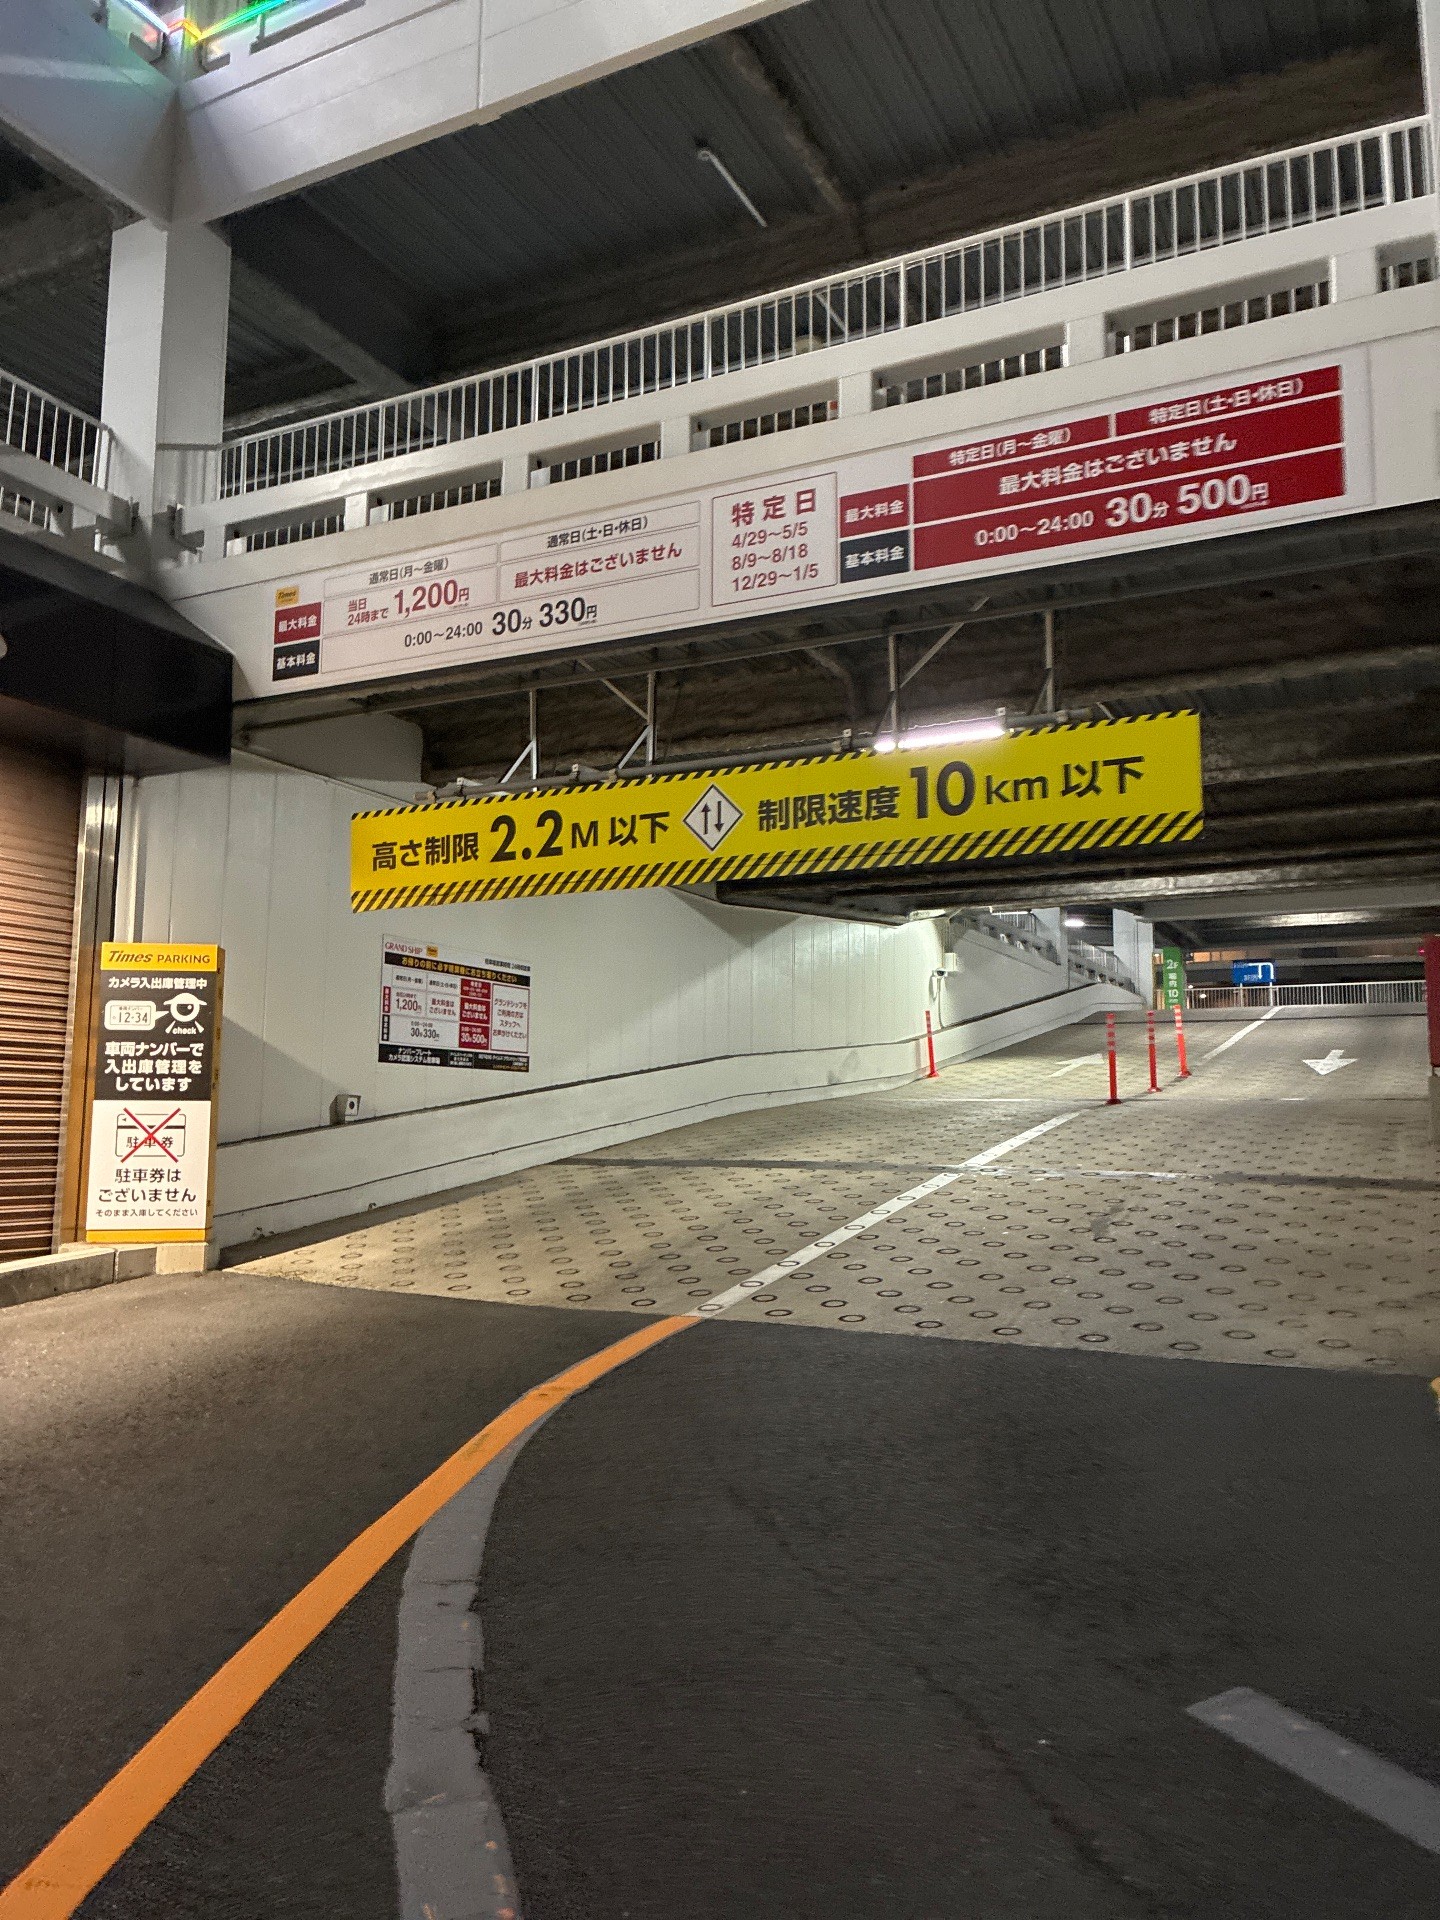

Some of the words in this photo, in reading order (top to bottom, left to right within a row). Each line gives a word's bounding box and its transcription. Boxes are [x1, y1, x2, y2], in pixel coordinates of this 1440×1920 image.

[999, 433, 1237, 495] 最大料金はございません
[1177, 473, 1269, 515] 500円
[731, 488, 816, 527] 特定日
[844, 500, 904, 523] 最大料金
[514, 543, 682, 588] 最大料金はございません
[845, 545, 904, 569] 基本料金
[348, 598, 367, 612] 当日
[394, 579, 470, 618] 1,200円
[348, 608, 389, 626] 24時まで
[539, 597, 598, 628] 330円
[278, 614, 317, 633] 最大料金
[276, 651, 316, 670] 基本料金
[757, 785, 901, 832] 制限速度
[371, 831, 479, 872] 高さ制限
[385, 941, 407, 952] GRAND
[408, 945, 423, 955] SHIP
[108, 951, 153, 963] Times
[157, 954, 211, 964] PARKING
[108, 977, 207, 990] カメラ入出庫管理中
[172, 1027, 196, 1035] check
[104, 1041, 204, 1057] 車両ナンバーで
[104, 1059, 202, 1074] 入出庫管理を
[115, 1077, 192, 1091] しています
[126, 1136, 173, 1148] 駐車券
[115, 1168, 182, 1183] 駐車券は
[98, 1187, 196, 1202] ございません
[96, 1208, 198, 1217] そのまま入庫してください
